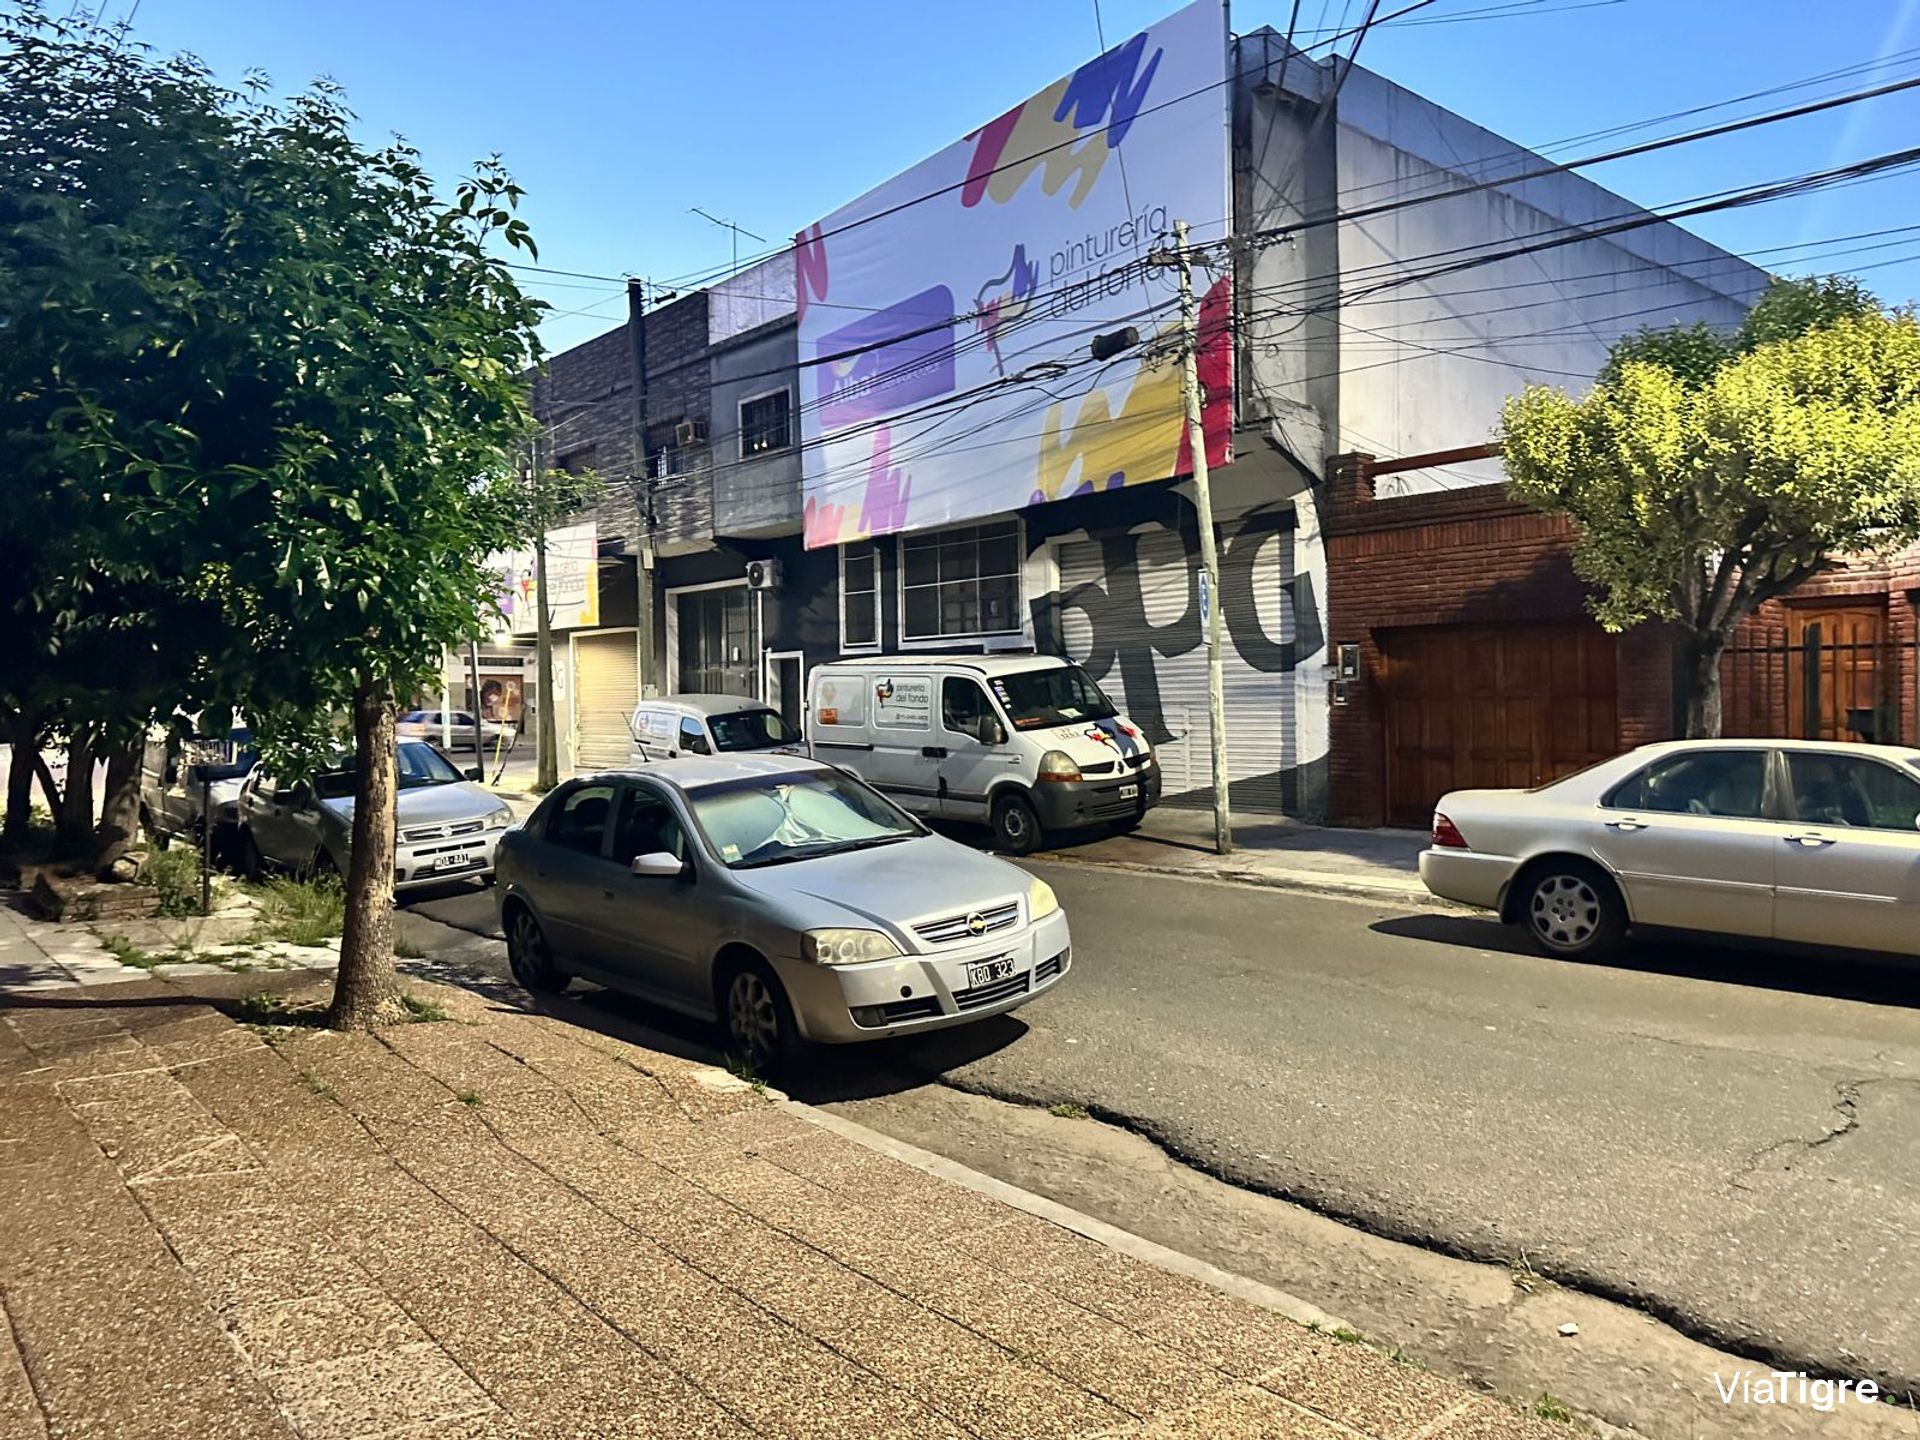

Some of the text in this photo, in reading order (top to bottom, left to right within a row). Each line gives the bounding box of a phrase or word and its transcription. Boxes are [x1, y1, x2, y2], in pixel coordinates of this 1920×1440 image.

[1050, 204, 1166, 288] pinturería
[1100, 240, 1180, 301] fond
[995, 960, 1014, 979] 323
